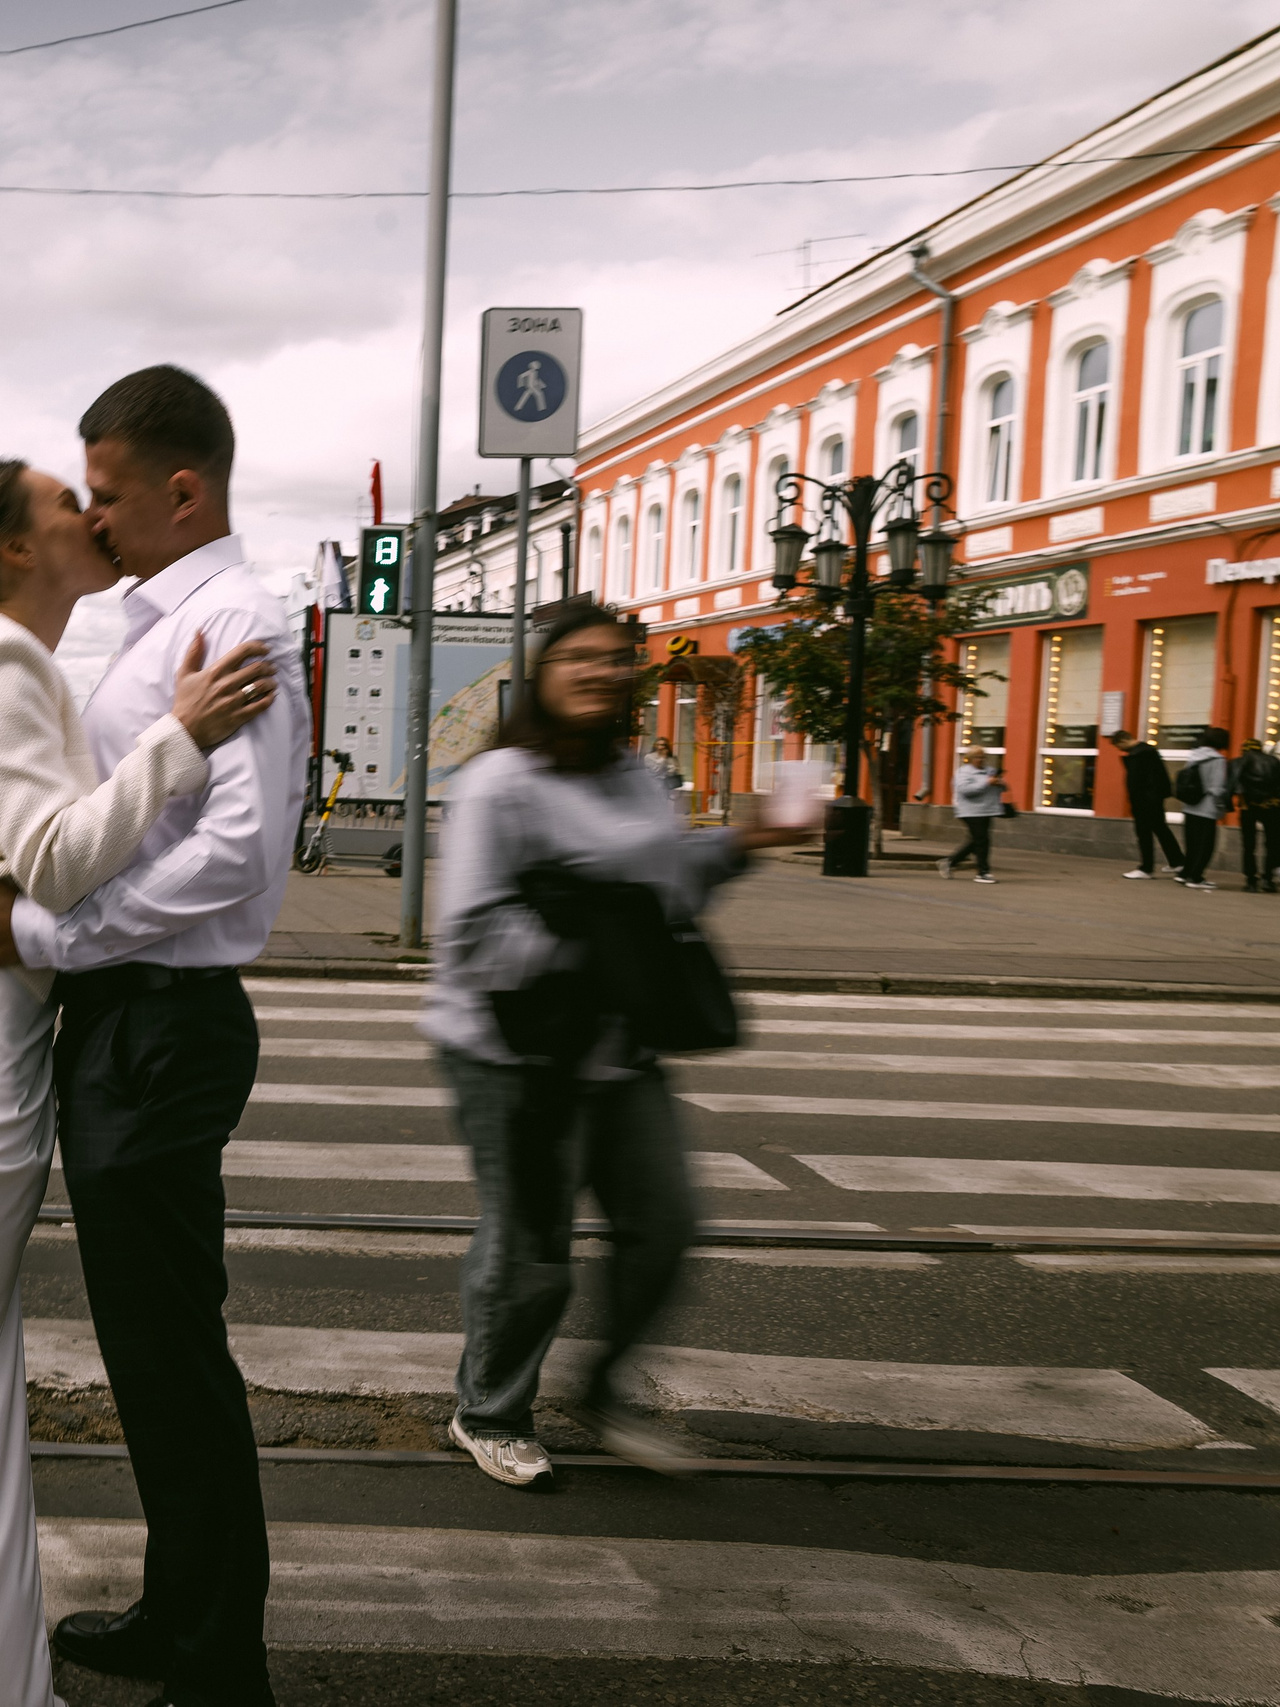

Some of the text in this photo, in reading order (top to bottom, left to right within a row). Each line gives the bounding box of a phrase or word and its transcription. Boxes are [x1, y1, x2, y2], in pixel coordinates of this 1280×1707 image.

[507, 317, 563, 333] ЗОНА
[375, 536, 399, 565] 8
[431, 624, 482, 633] сторической
